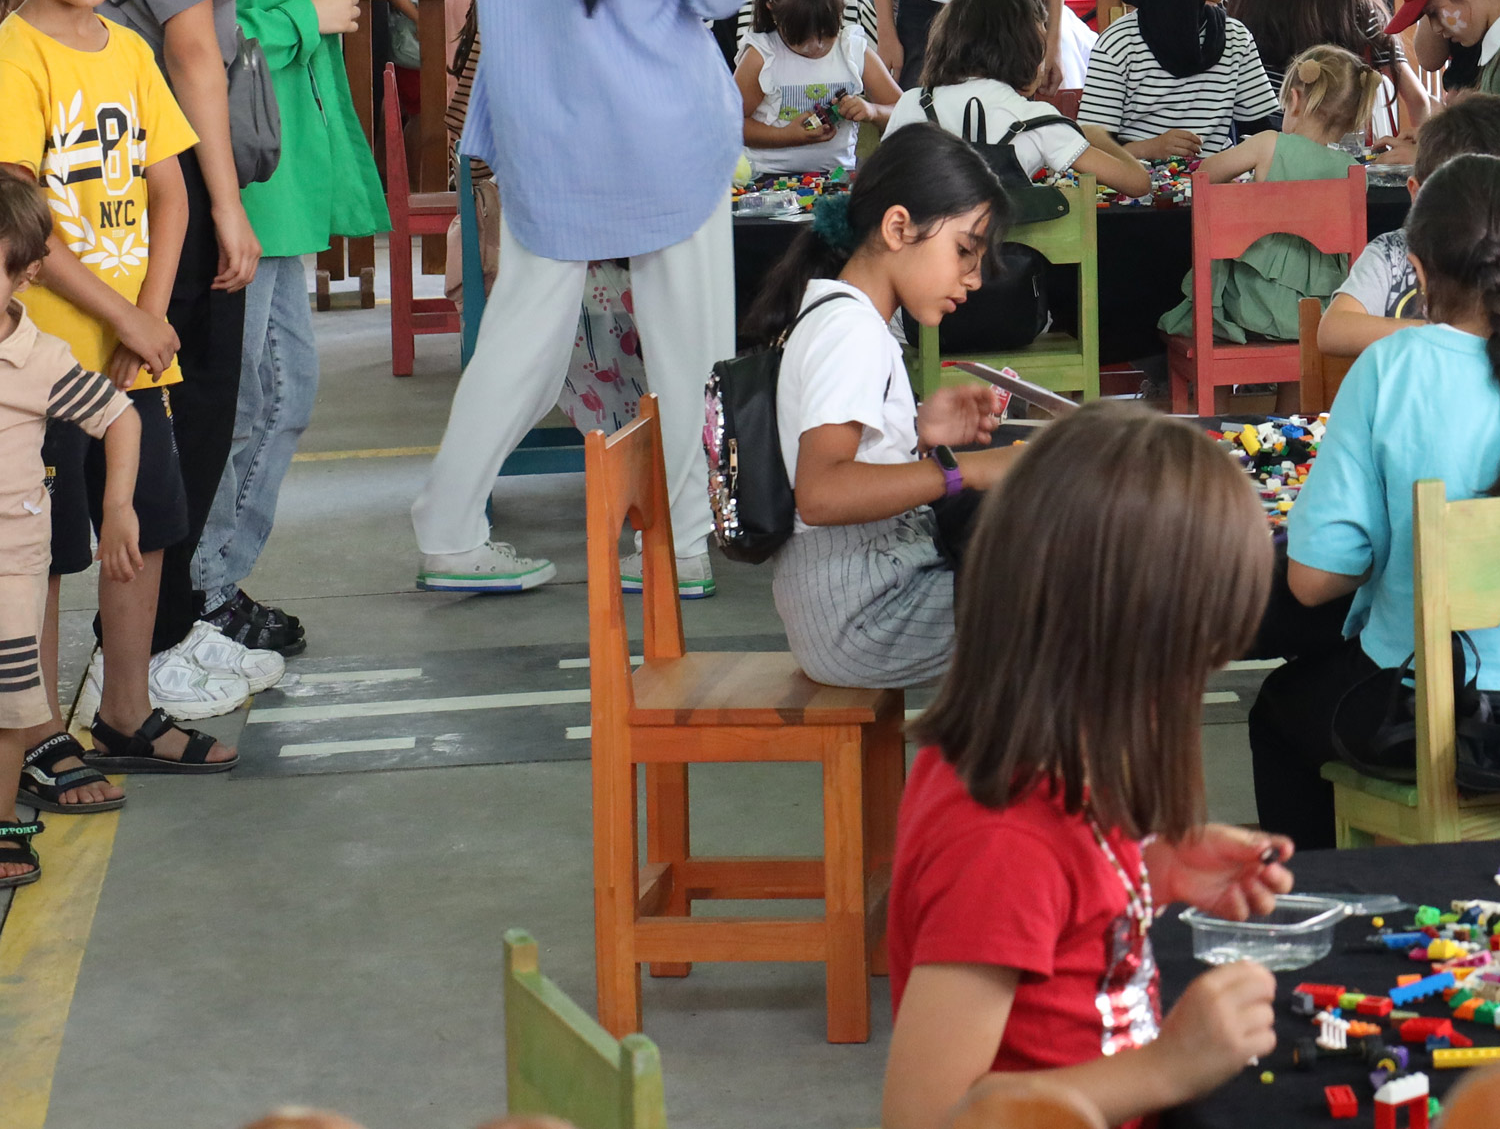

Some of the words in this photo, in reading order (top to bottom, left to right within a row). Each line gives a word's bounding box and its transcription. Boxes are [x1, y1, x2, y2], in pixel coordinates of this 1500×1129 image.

[100, 199, 137, 228] NYC
[25, 734, 71, 762] SUPPORT
[0, 825, 38, 836] PPORT
